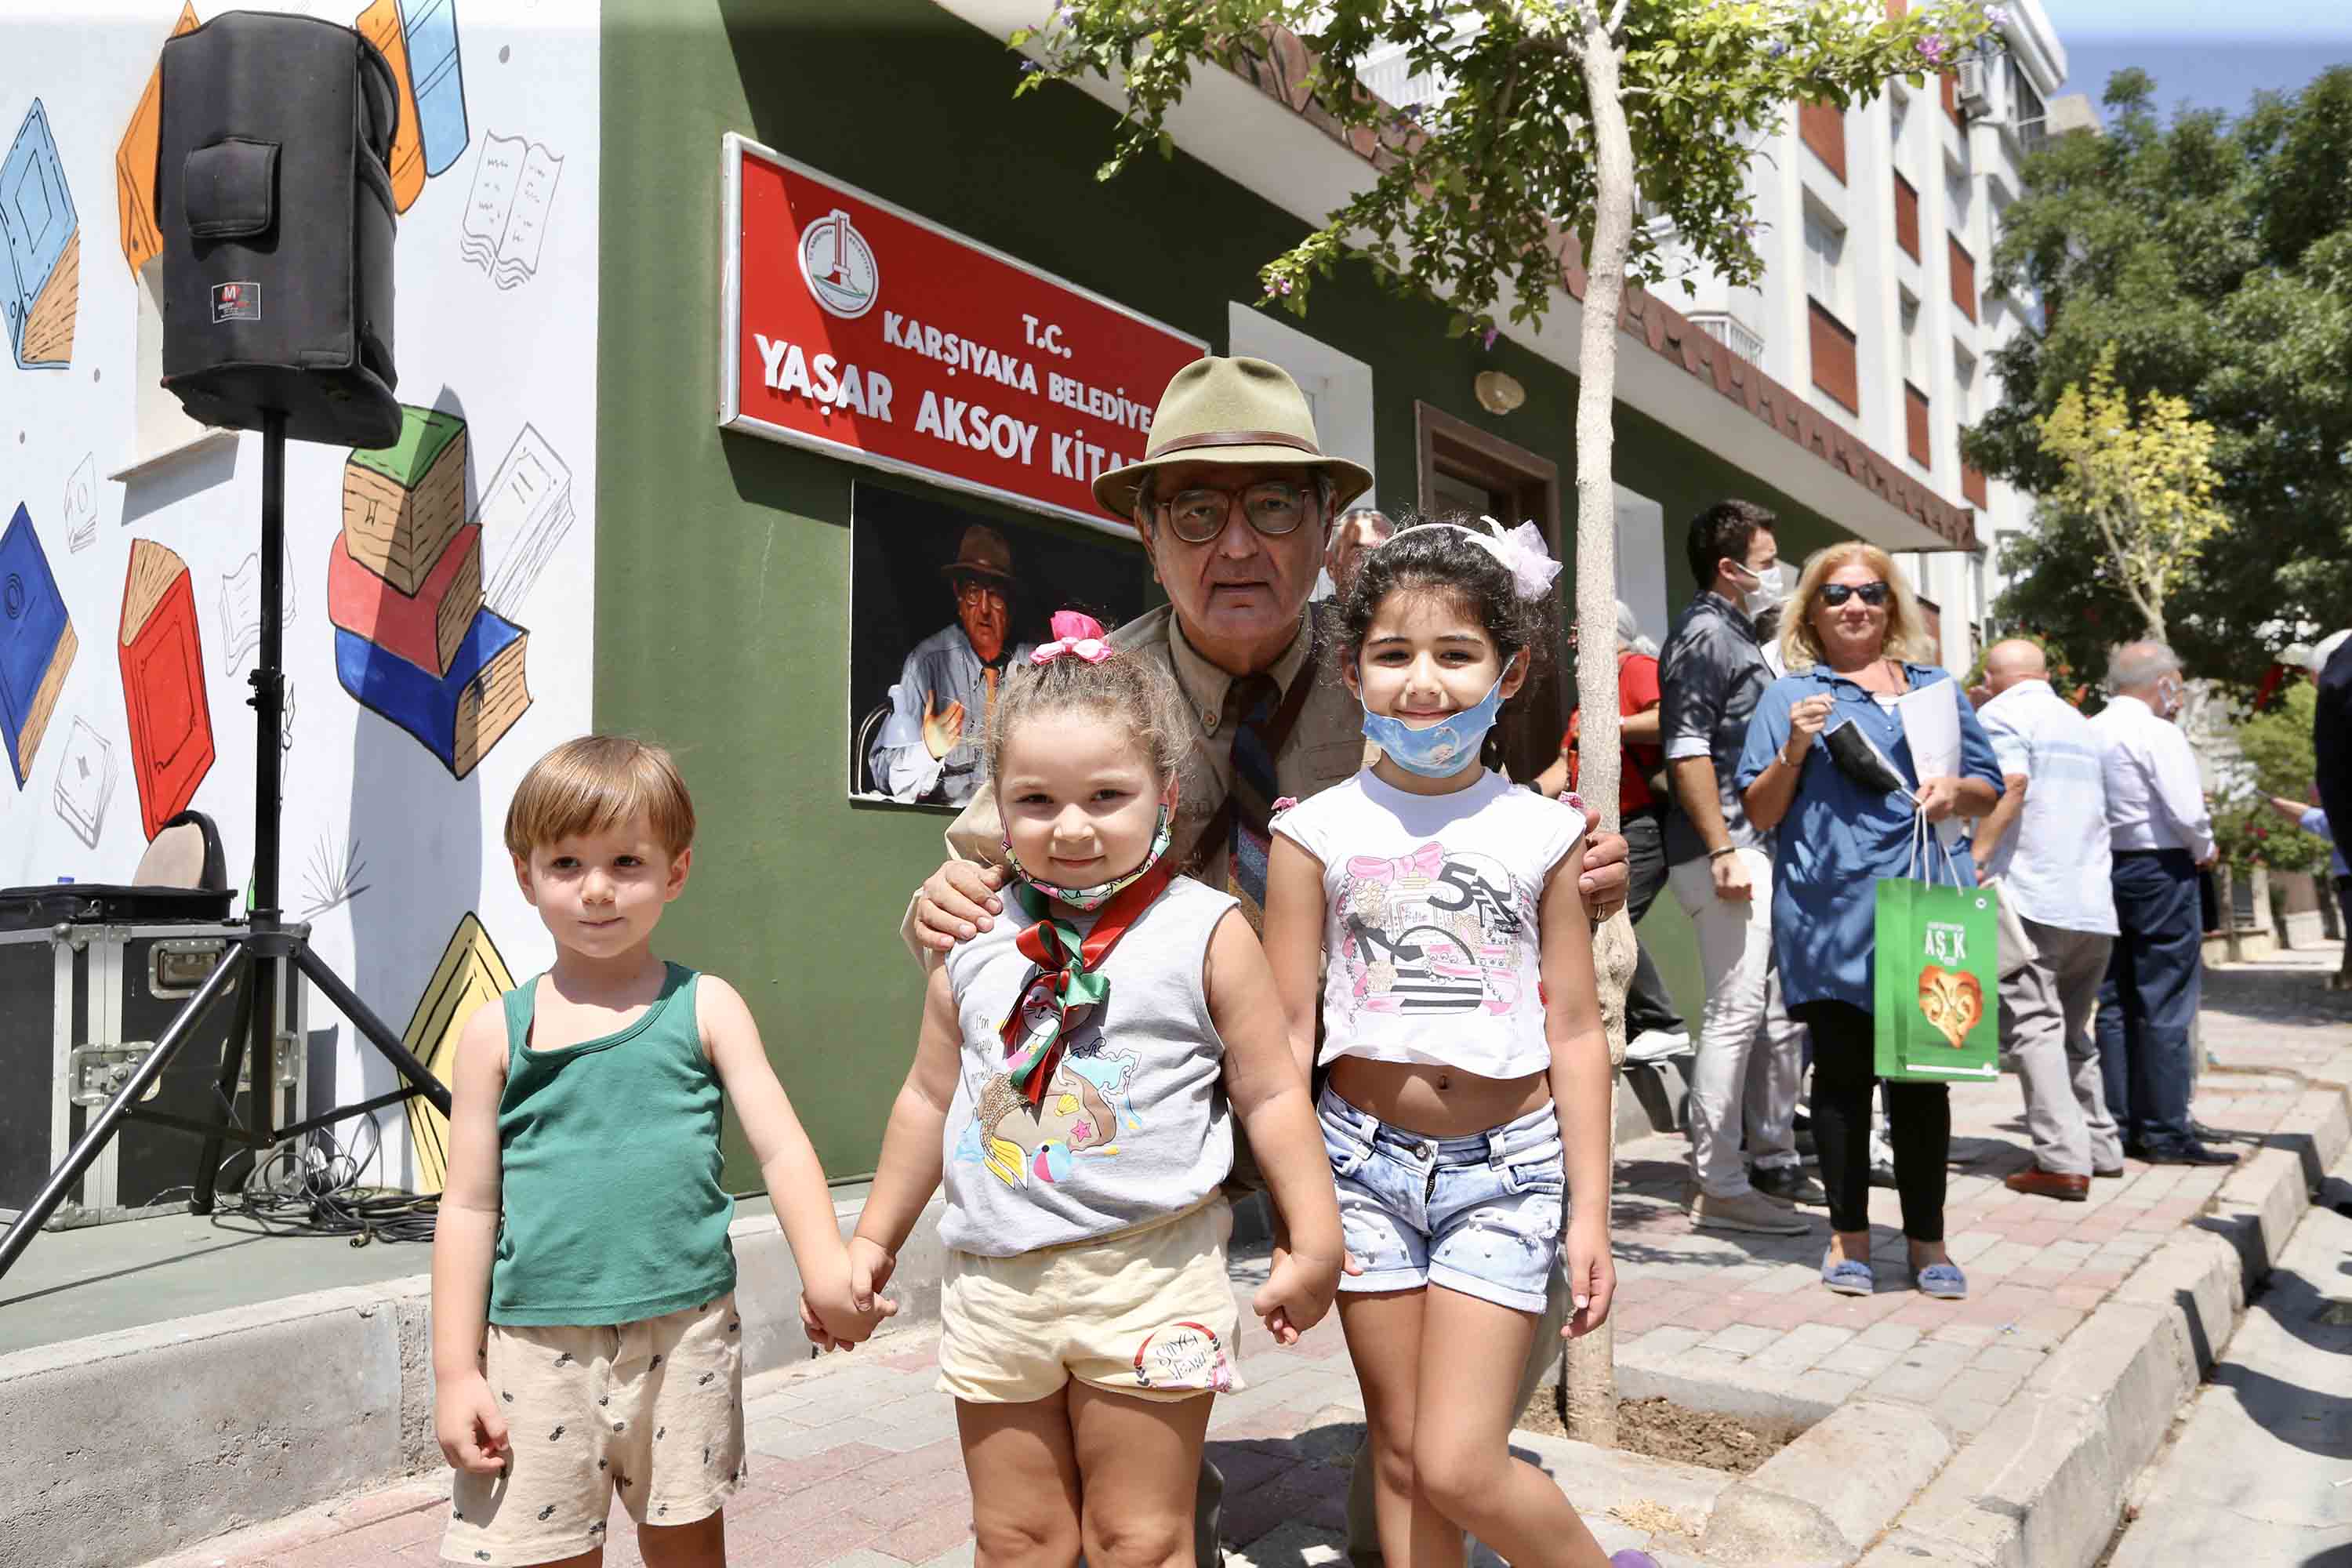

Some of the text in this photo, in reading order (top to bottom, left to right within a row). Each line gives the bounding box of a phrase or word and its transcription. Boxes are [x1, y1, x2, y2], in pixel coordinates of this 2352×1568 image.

[884, 310, 1152, 434] KARŞIYAKA BELEDİYE
[1022, 314, 1072, 358] T.C.
[753, 332, 1143, 485] YAŞAR AKSOY KİT
